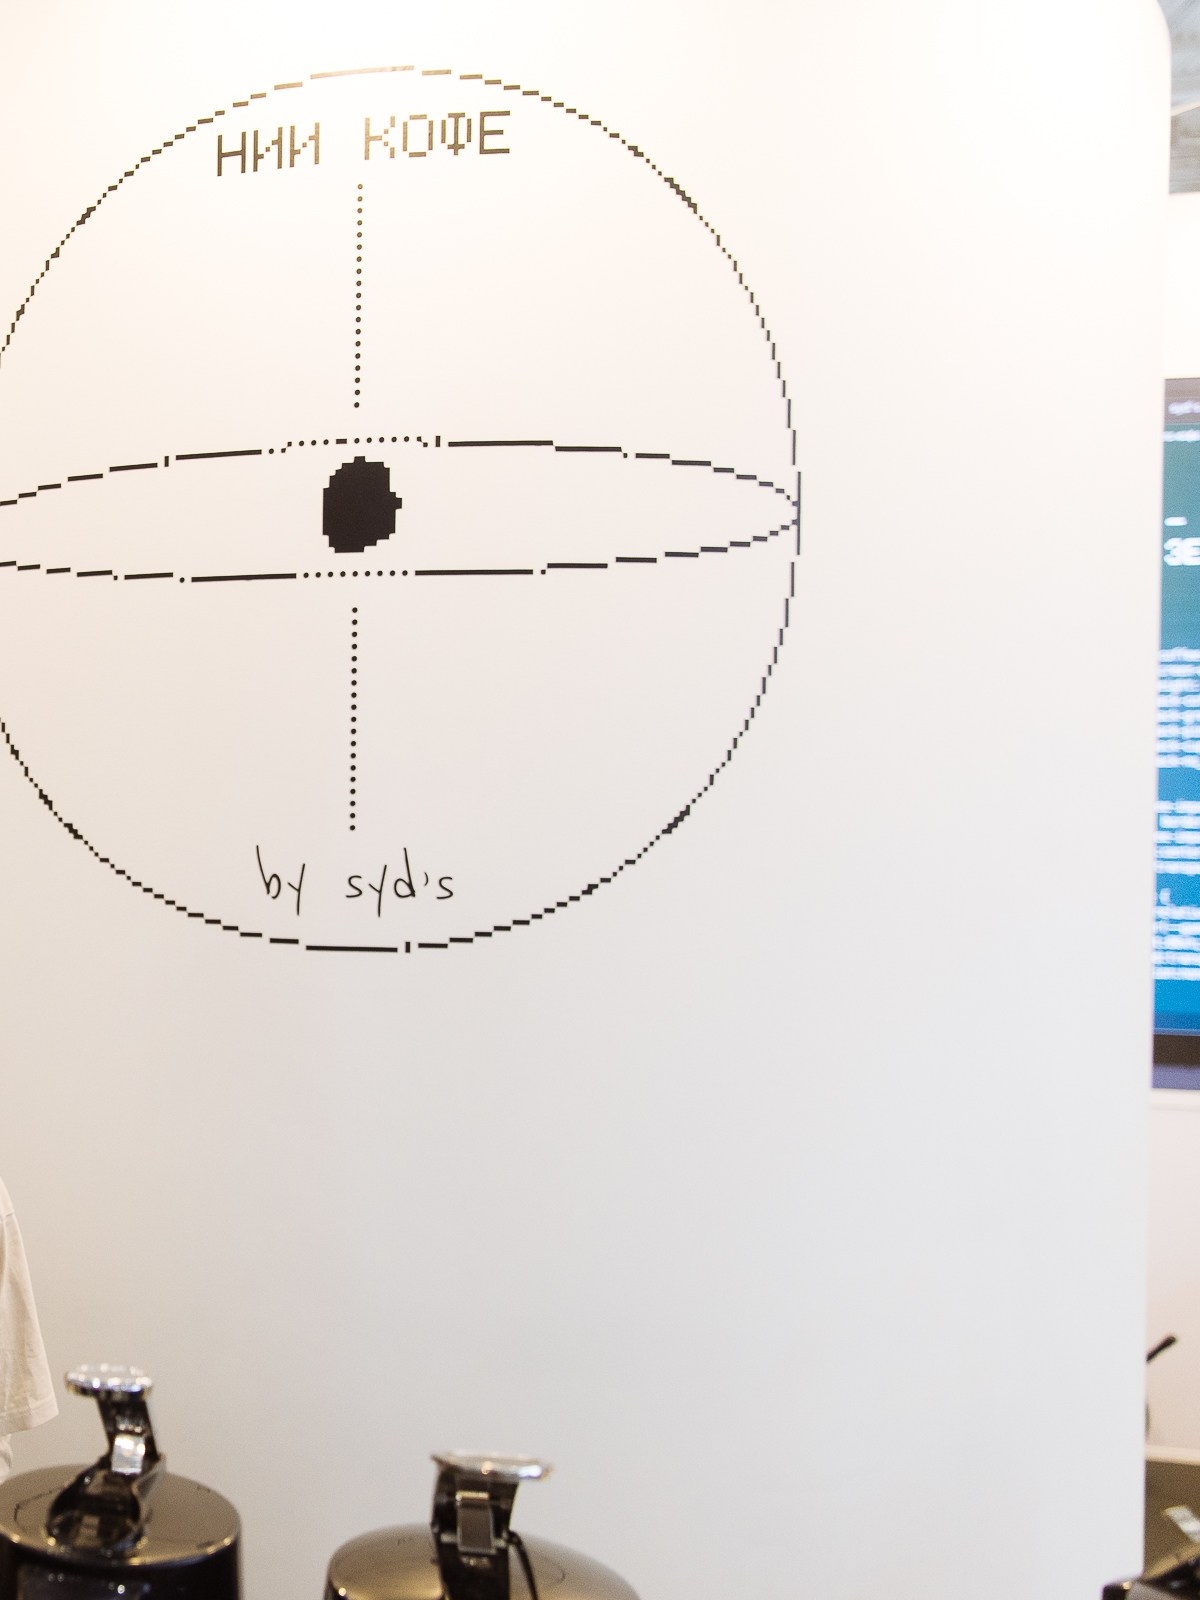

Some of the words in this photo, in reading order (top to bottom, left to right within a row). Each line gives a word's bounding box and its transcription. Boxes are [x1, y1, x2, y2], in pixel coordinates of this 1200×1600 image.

[217, 122, 320, 177] НИИ
[364, 110, 511, 161] КОФЕ
[256, 845, 306, 916] by
[345, 847, 454, 917] syd's
